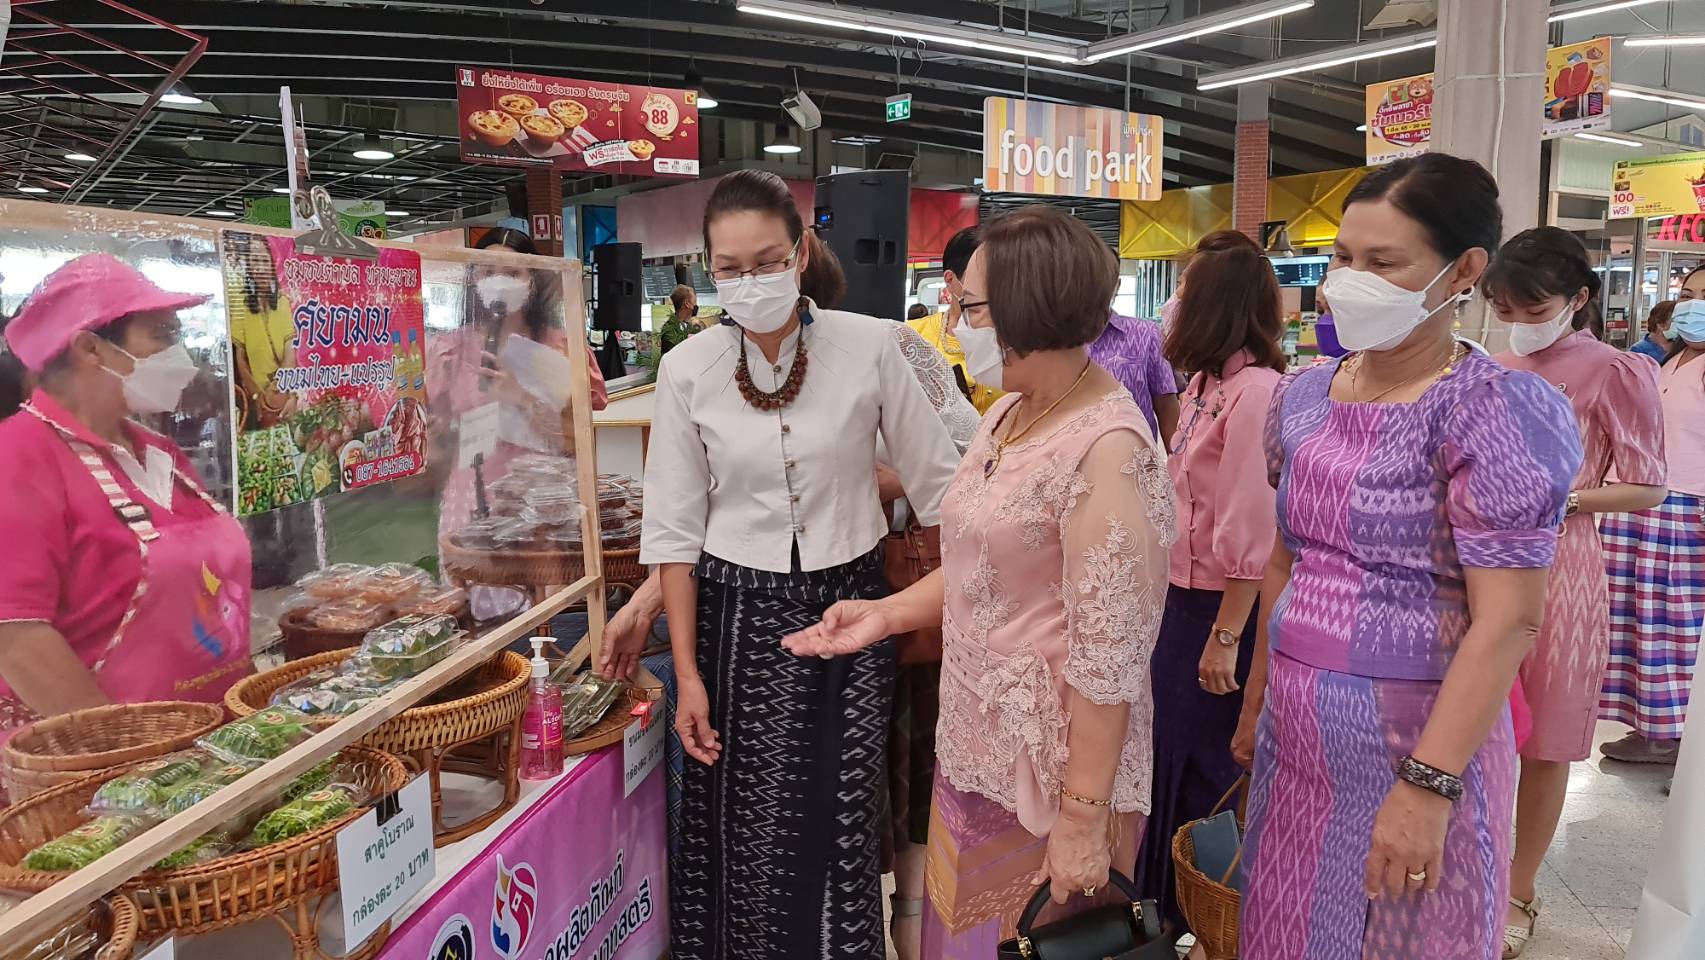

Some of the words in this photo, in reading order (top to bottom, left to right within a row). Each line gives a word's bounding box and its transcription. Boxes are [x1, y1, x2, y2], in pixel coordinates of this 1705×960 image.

[652, 109, 668, 125] 88
[1001, 129, 1074, 179] food
[1085, 142, 1153, 190] park
[1614, 192, 1634, 203] 100
[1657, 213, 1705, 243] KFC
[284, 257, 361, 288] ชุมชนตำบล
[364, 814, 415, 863] สาคูโบราณ
[352, 882, 392, 927] กล่องละ
[395, 871, 405, 891] 20
[409, 847, 429, 878] บาท
